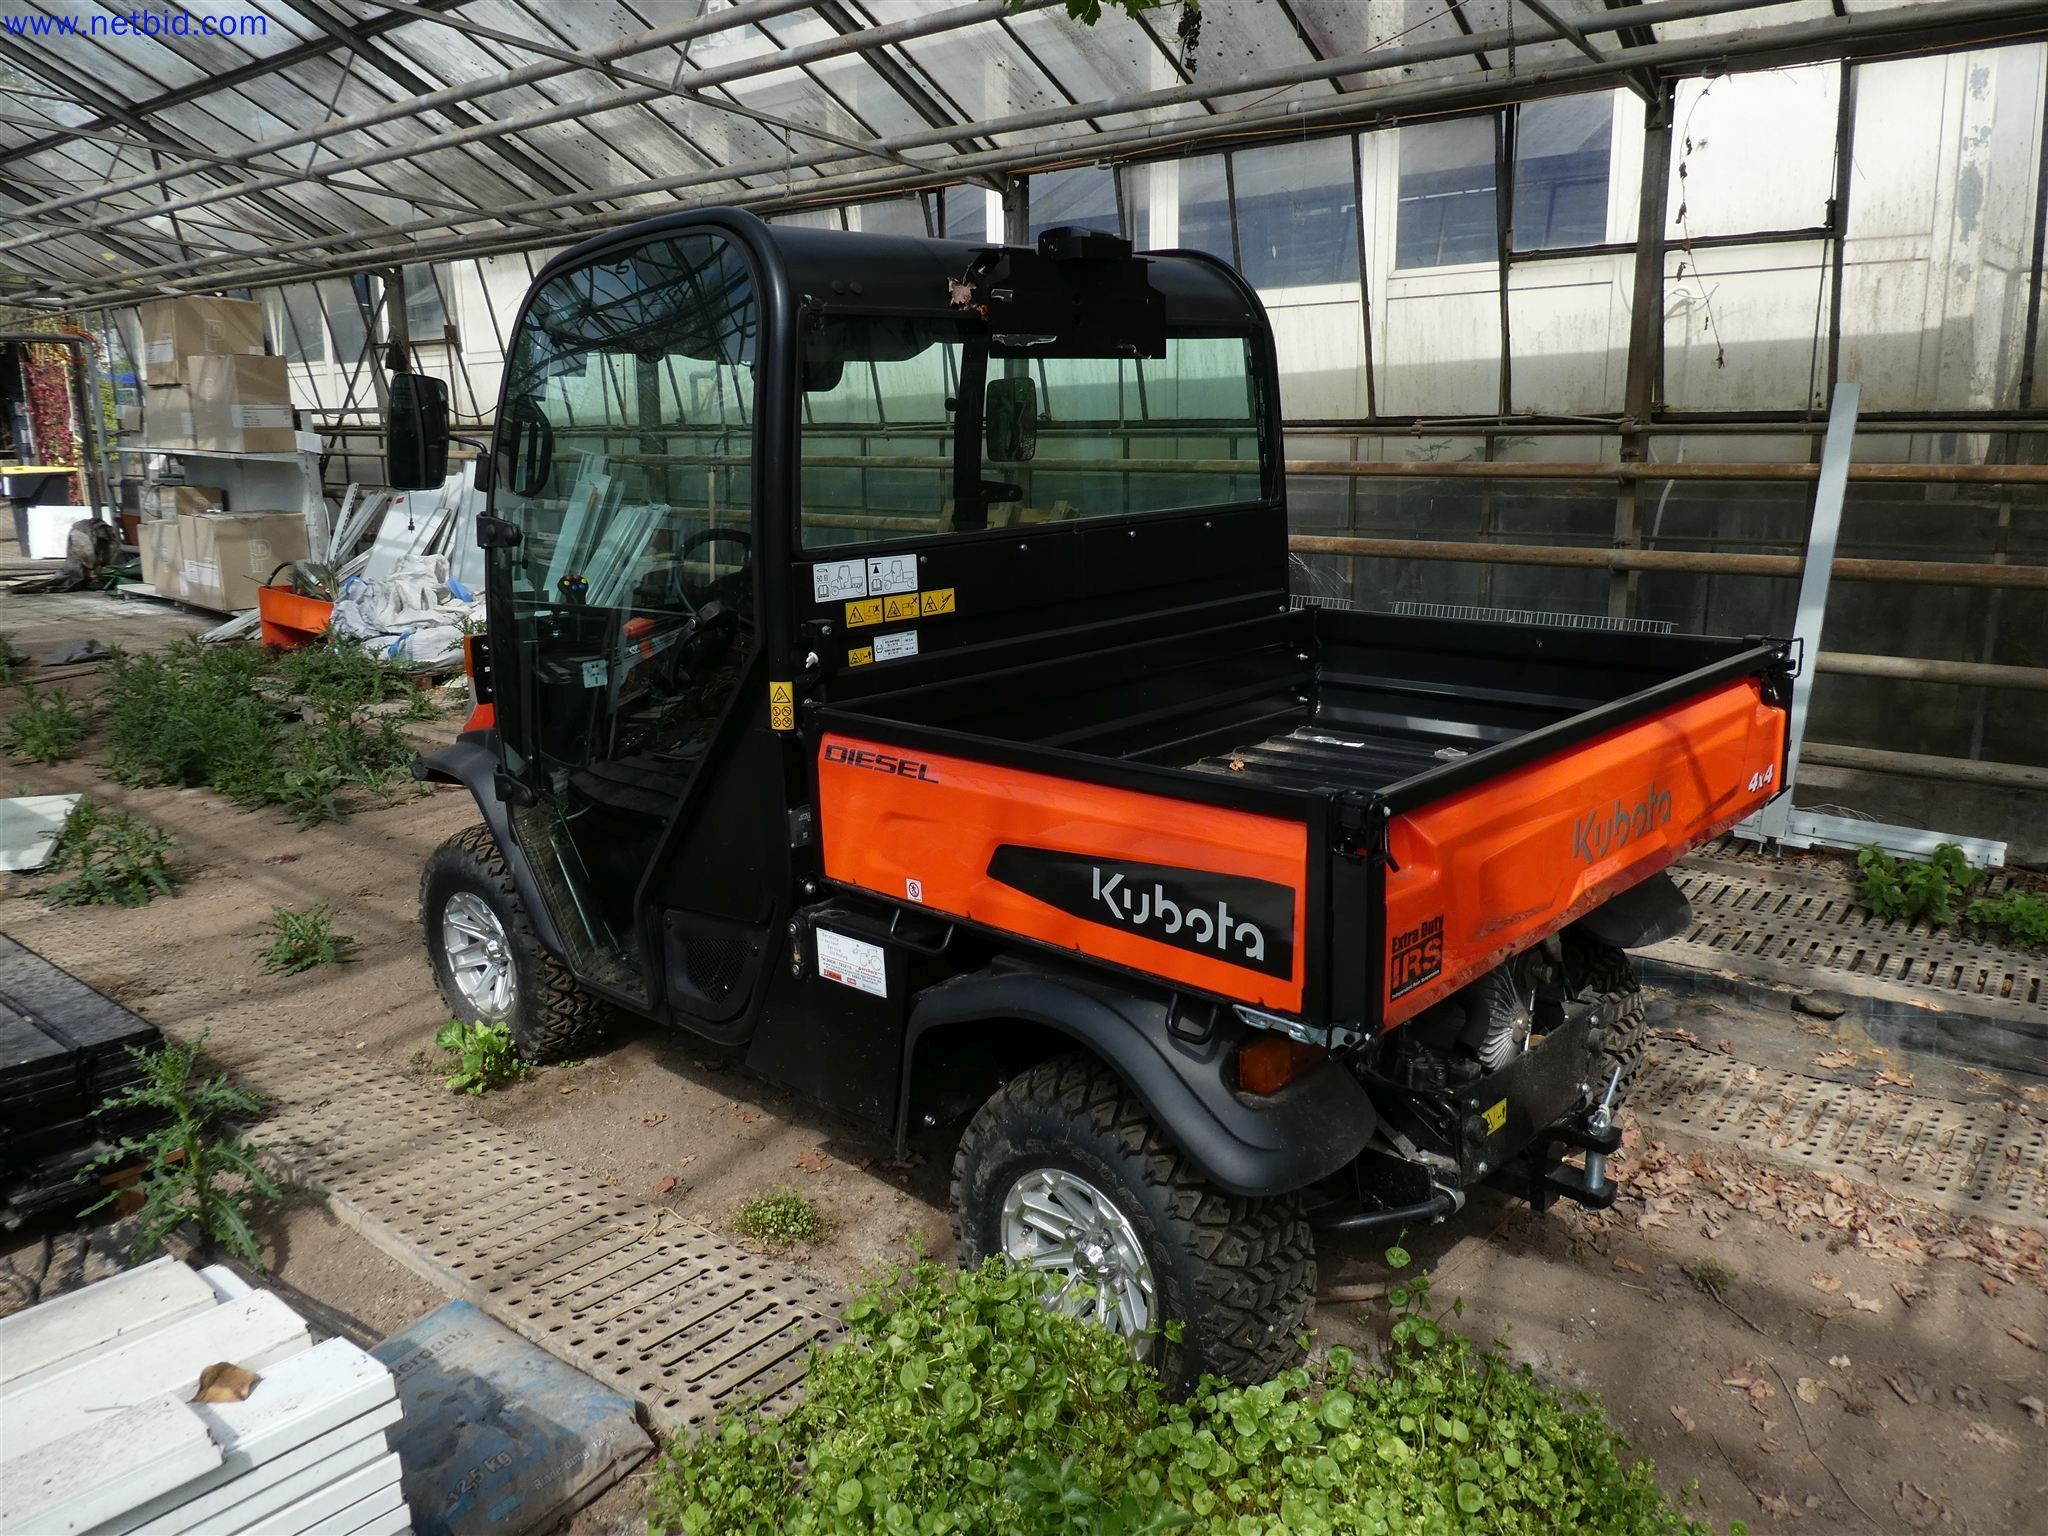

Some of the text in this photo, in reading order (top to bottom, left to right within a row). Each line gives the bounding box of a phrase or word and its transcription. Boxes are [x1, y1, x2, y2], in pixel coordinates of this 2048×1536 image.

[824, 744, 939, 784] DIESEL
[1747, 763, 1774, 794] 4x4
[1572, 782, 1672, 865] Kubota
[1092, 866, 1265, 961] Kubota
[1393, 914, 1444, 952] Extra Duty
[1393, 939, 1441, 989] IRS
[446, 1450, 513, 1505] 12,5 kg
